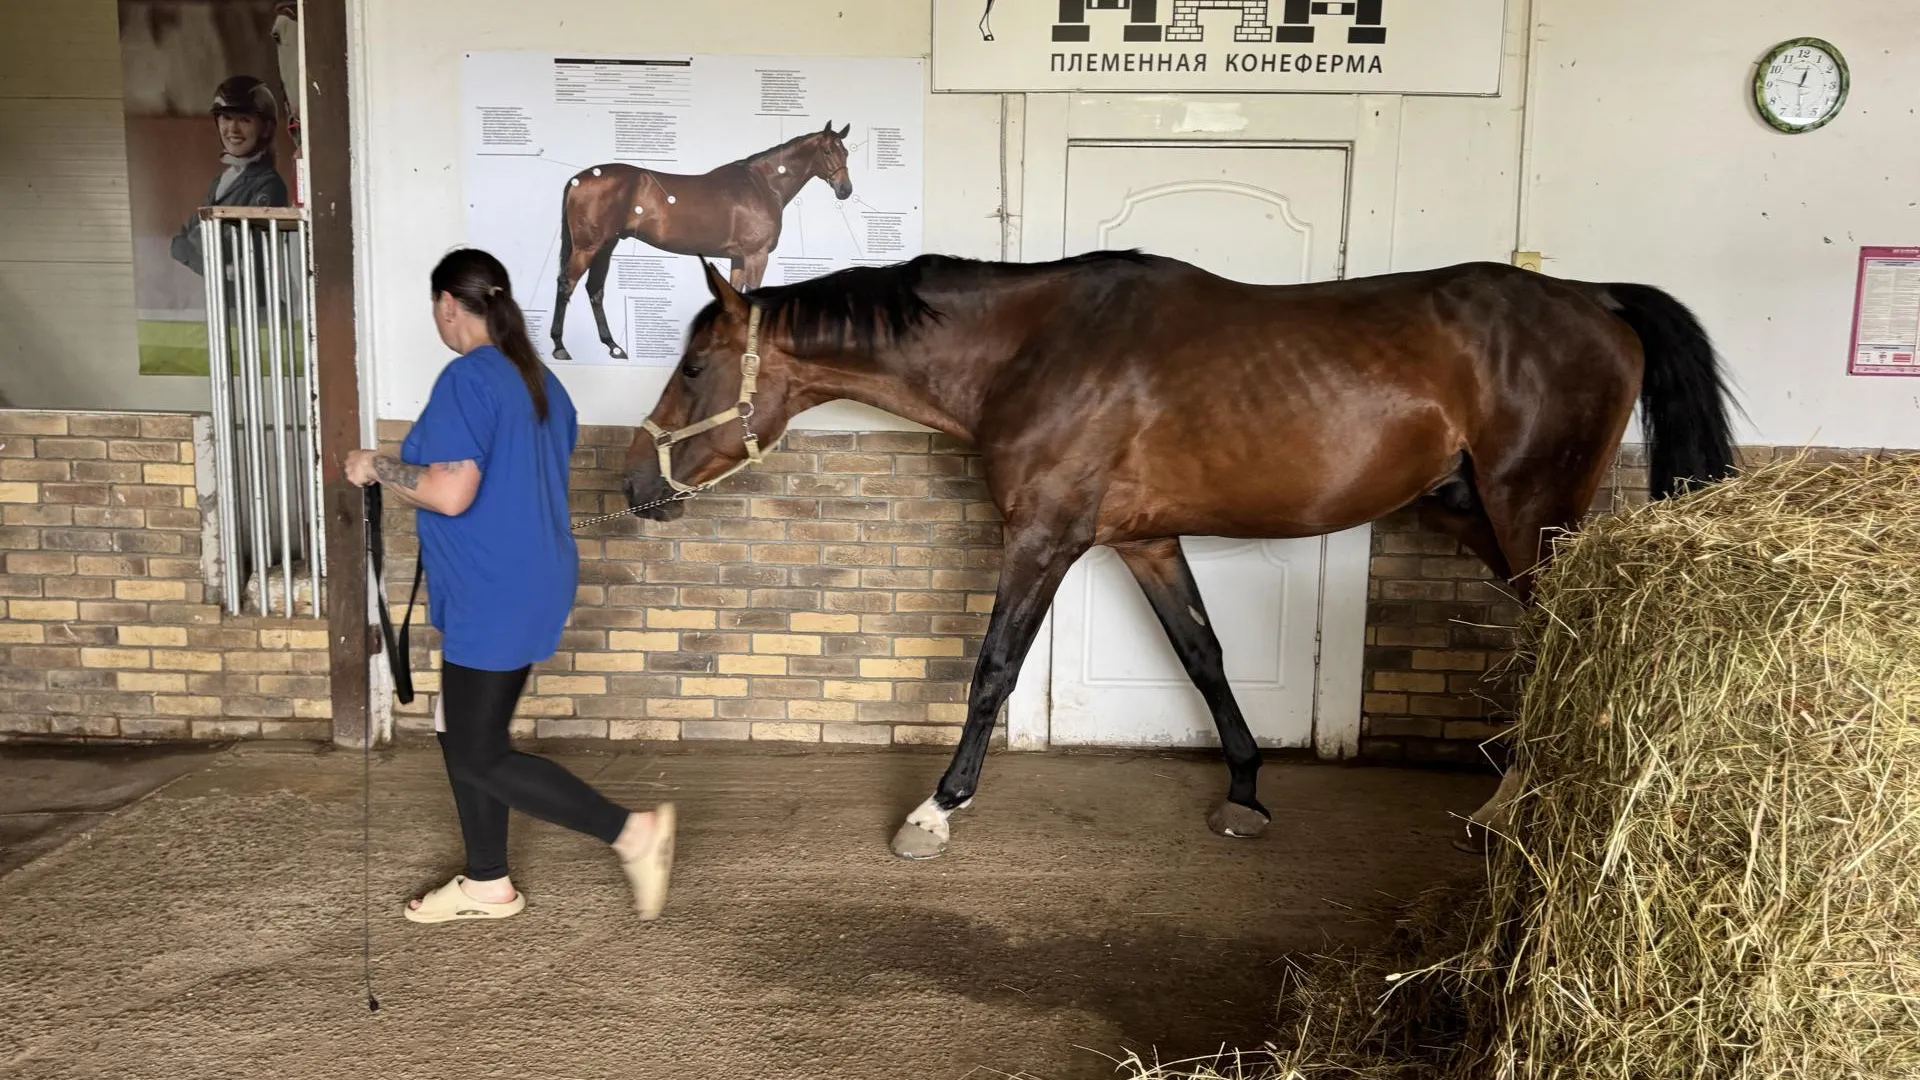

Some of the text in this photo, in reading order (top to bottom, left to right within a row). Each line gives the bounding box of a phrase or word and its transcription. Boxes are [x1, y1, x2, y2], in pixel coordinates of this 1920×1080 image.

[1798, 49, 1810, 58] 12
[1051, 53, 1383, 73] ПЛЕМЕННАЯ КОНЕФЕРМА
[1783, 55, 1794, 63] 11
[1816, 55, 1822, 63] 1
[1770, 65, 1781, 74] 10
[1826, 65, 1833, 74] 2
[1766, 81, 1773, 89] 9
[1829, 81, 1836, 89] 3
[1769, 97, 1776, 105] 8
[1780, 107, 1787, 115] 7
